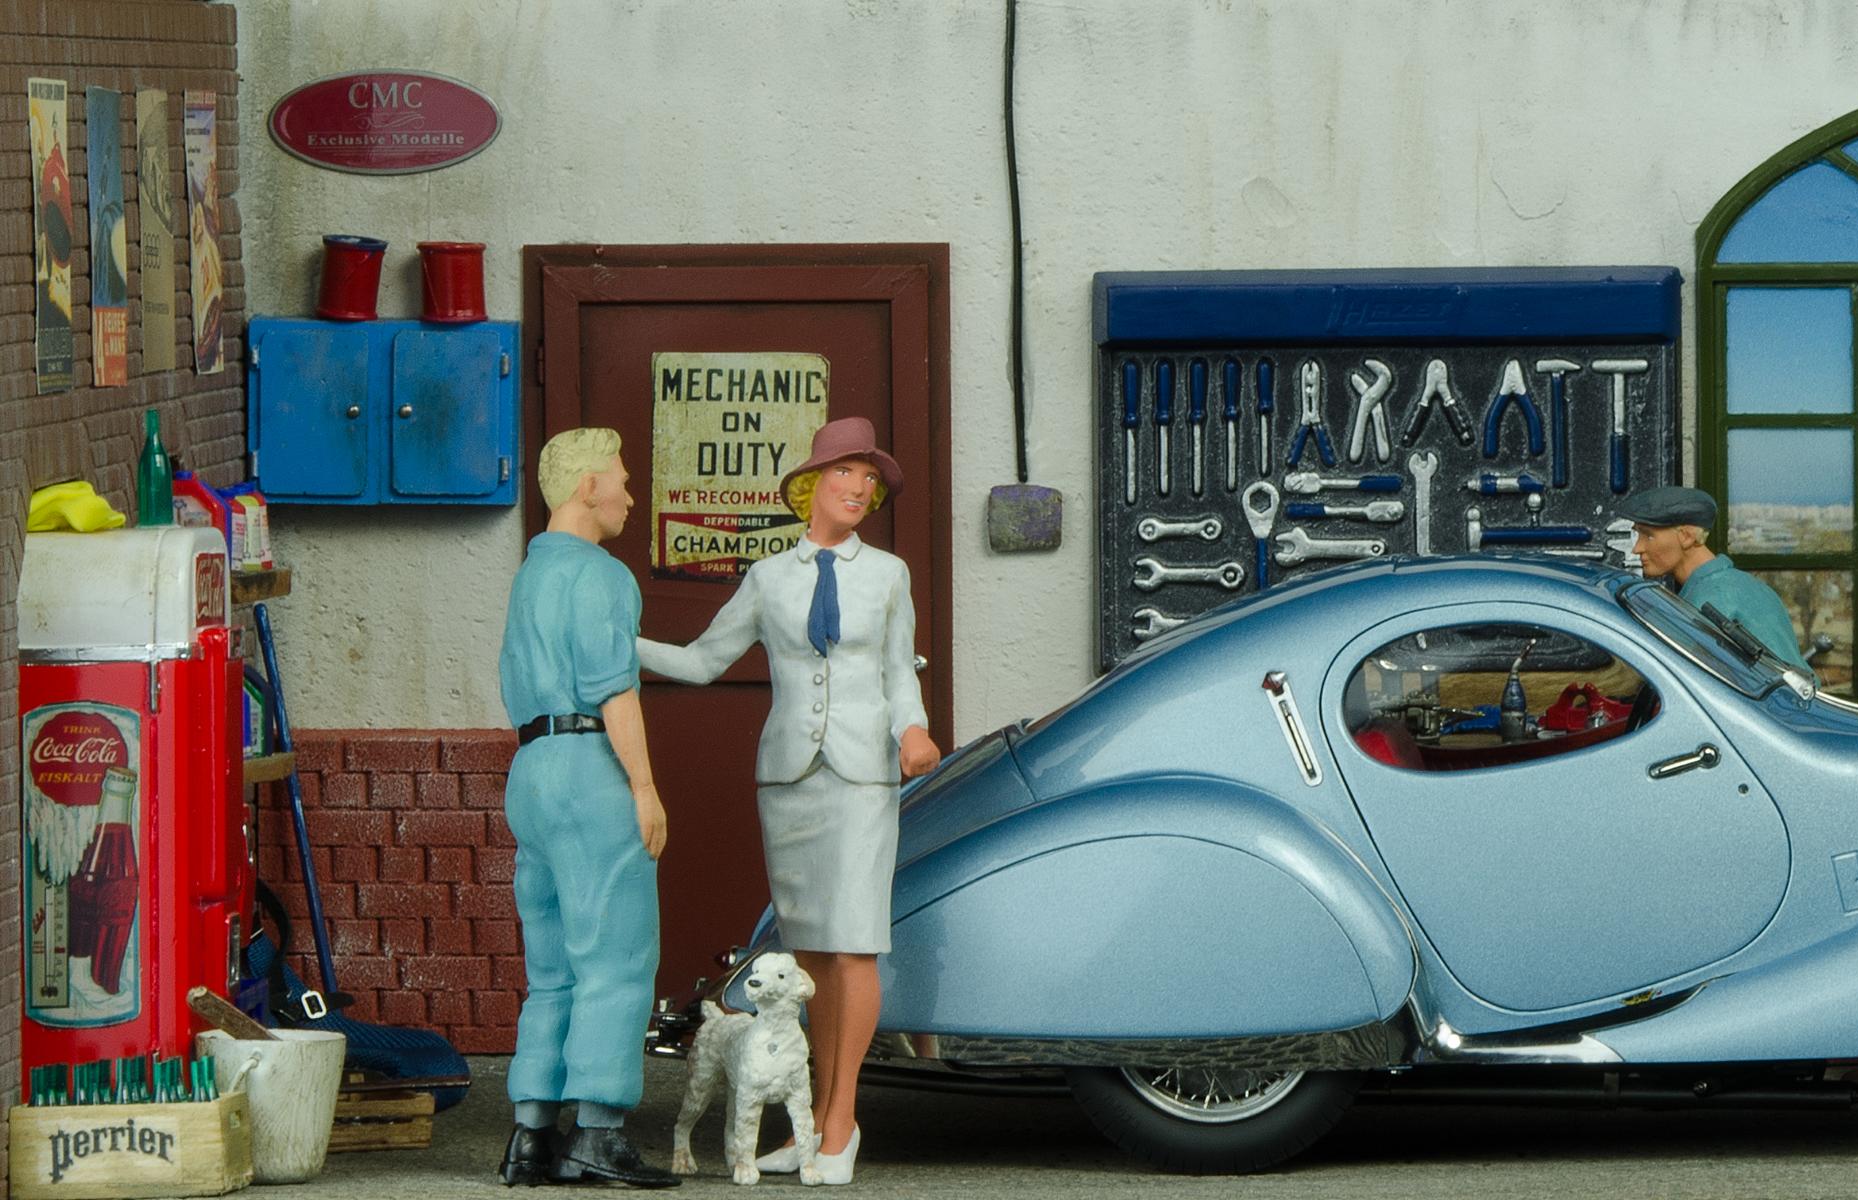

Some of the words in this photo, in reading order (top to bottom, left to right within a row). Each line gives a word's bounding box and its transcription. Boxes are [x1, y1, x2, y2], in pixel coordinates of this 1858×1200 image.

[348, 81, 422, 109] CMC
[307, 133, 385, 146] Exclusive
[391, 133, 465, 145] Modelle
[661, 368, 822, 404] MECHANIC
[722, 412, 761, 432] ON
[697, 442, 786, 477] DUTY
[668, 489, 691, 505] WE
[697, 490, 782, 505] RECOMME
[703, 516, 771, 528] DEPENDABLE
[673, 536, 800, 555] CHAMPION
[700, 562, 734, 573] SPARK
[62, 725, 102, 734] TRINK
[38, 772, 104, 784] EISKALT
[48, 1118, 174, 1184] perrier
